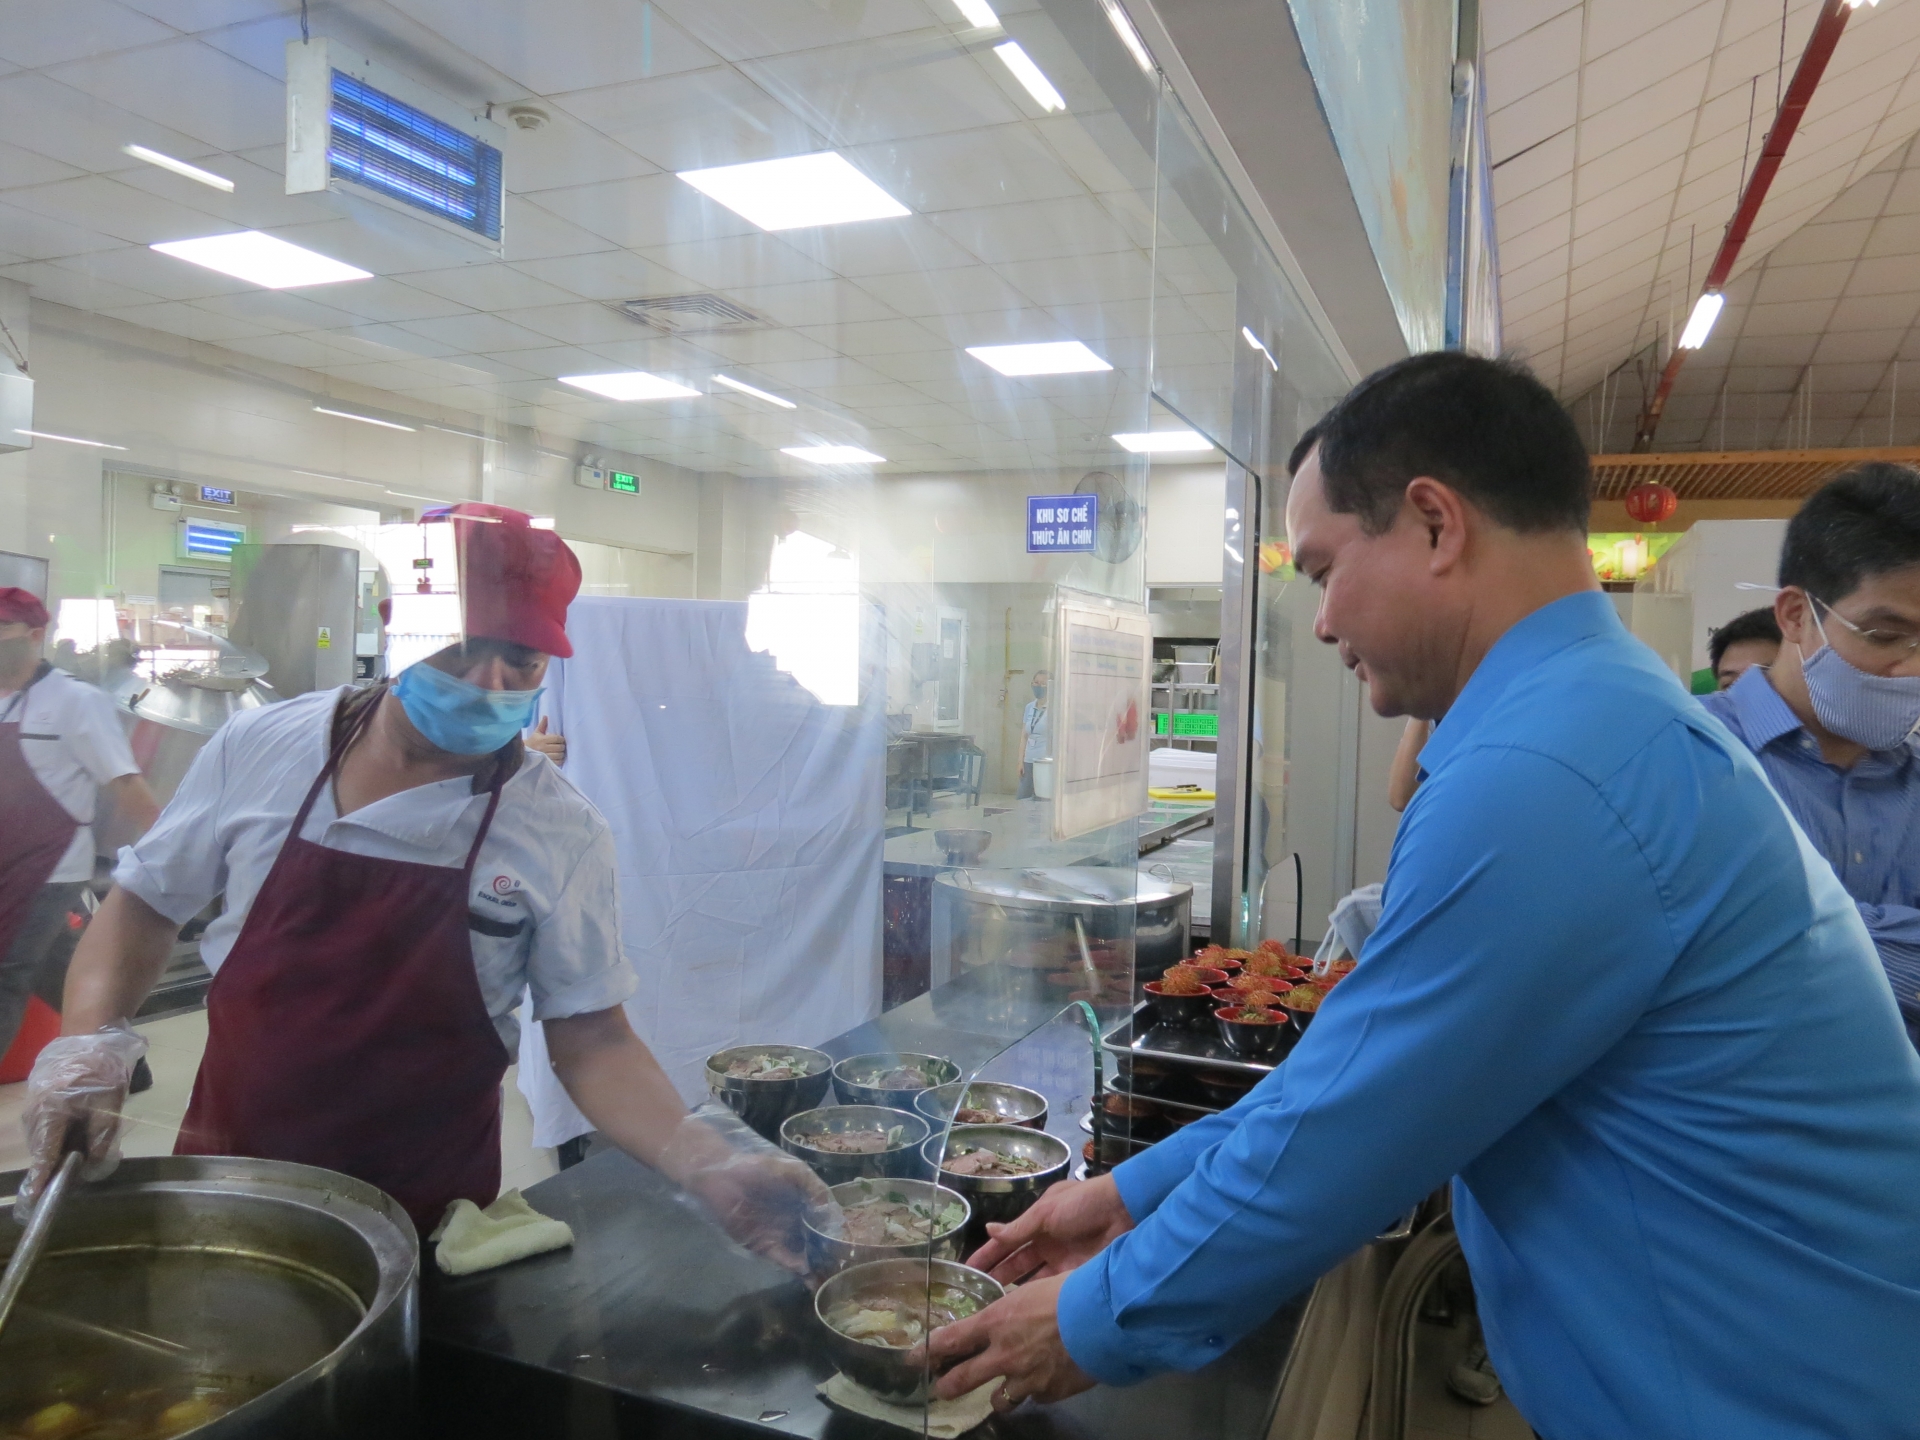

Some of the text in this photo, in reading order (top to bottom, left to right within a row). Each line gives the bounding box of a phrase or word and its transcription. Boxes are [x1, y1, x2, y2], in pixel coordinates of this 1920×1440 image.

[615, 473, 634, 484] EXIT
[204, 487, 231, 499] EXIT
[1036, 501, 1089, 524] KHU SƠ CHẾ
[1032, 526, 1092, 545] THỨC ĂN CHÍN
